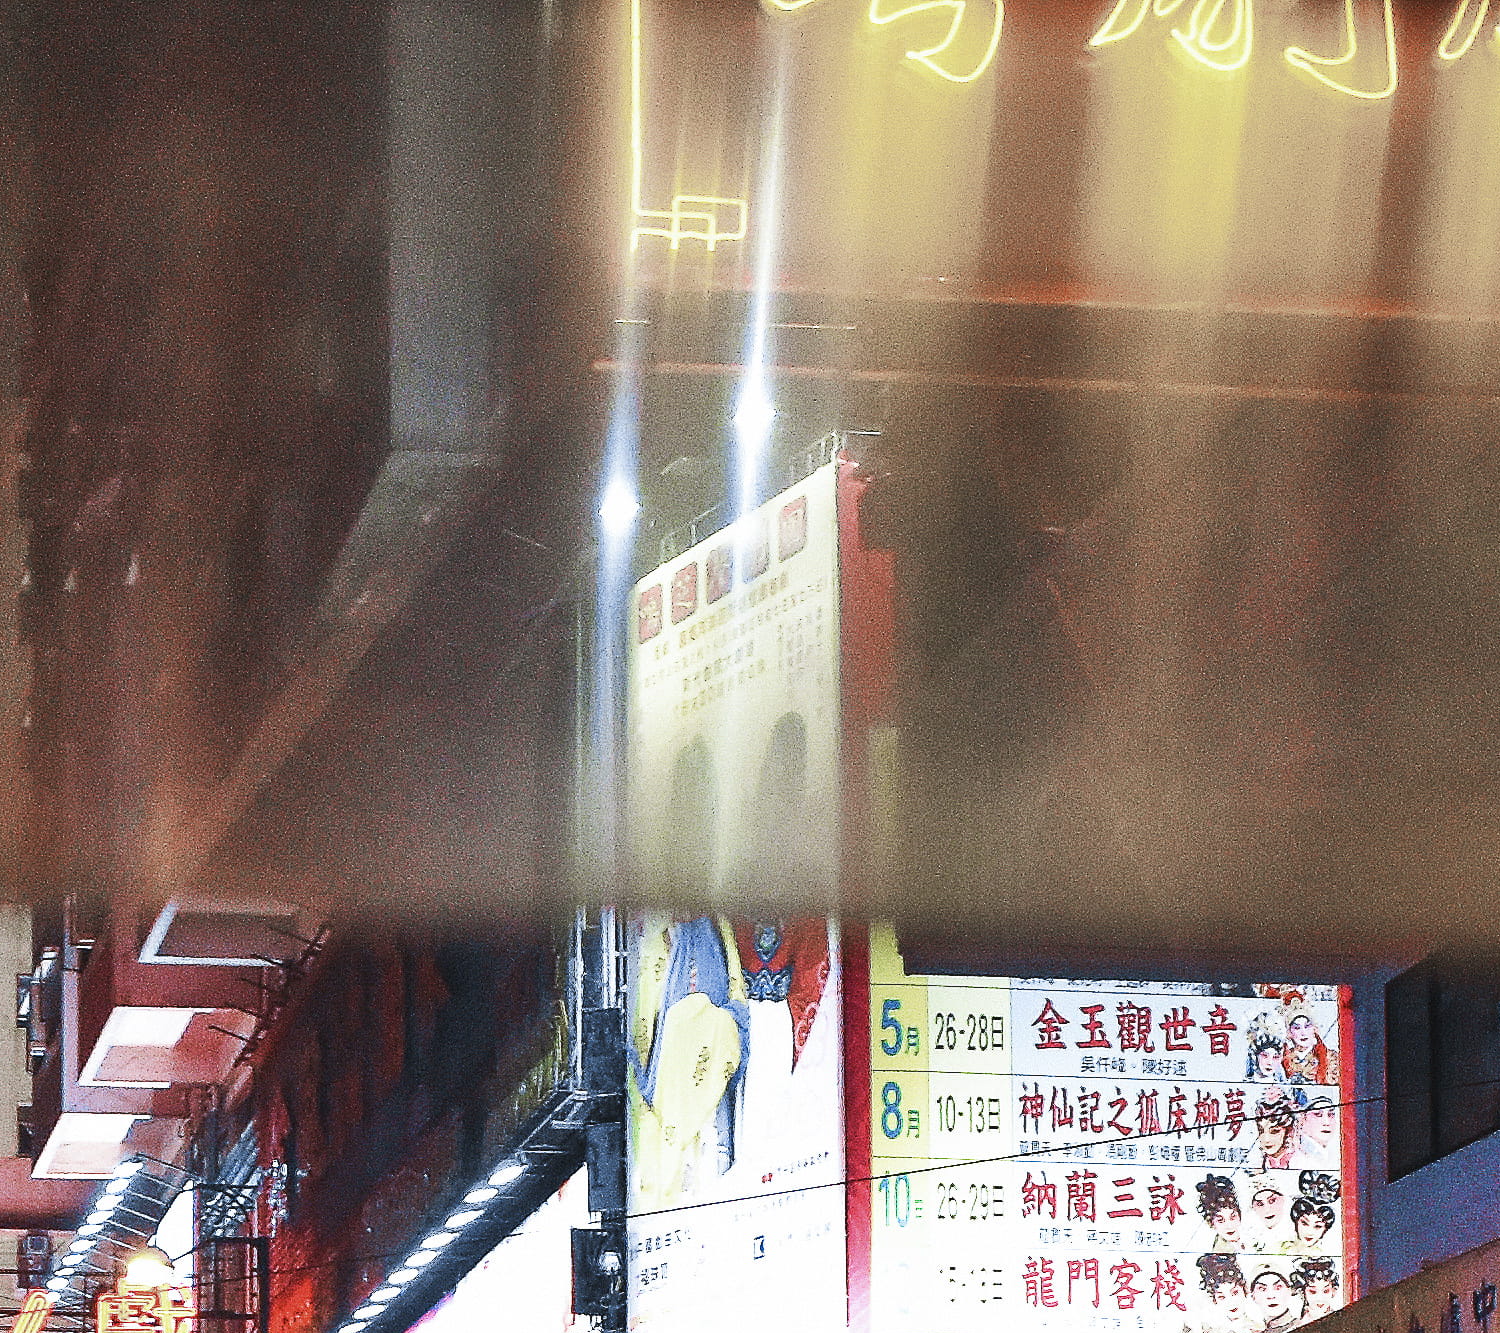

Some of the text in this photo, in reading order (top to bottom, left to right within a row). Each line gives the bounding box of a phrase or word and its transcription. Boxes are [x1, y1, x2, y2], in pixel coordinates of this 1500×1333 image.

[881, 998, 1238, 1056] 5月 26-28日 金玉觀世音
[881, 1082, 920, 1138] 8月
[936, 1097, 1001, 1133] 10-13日
[1022, 1255, 1188, 1312] 龍門客棧
